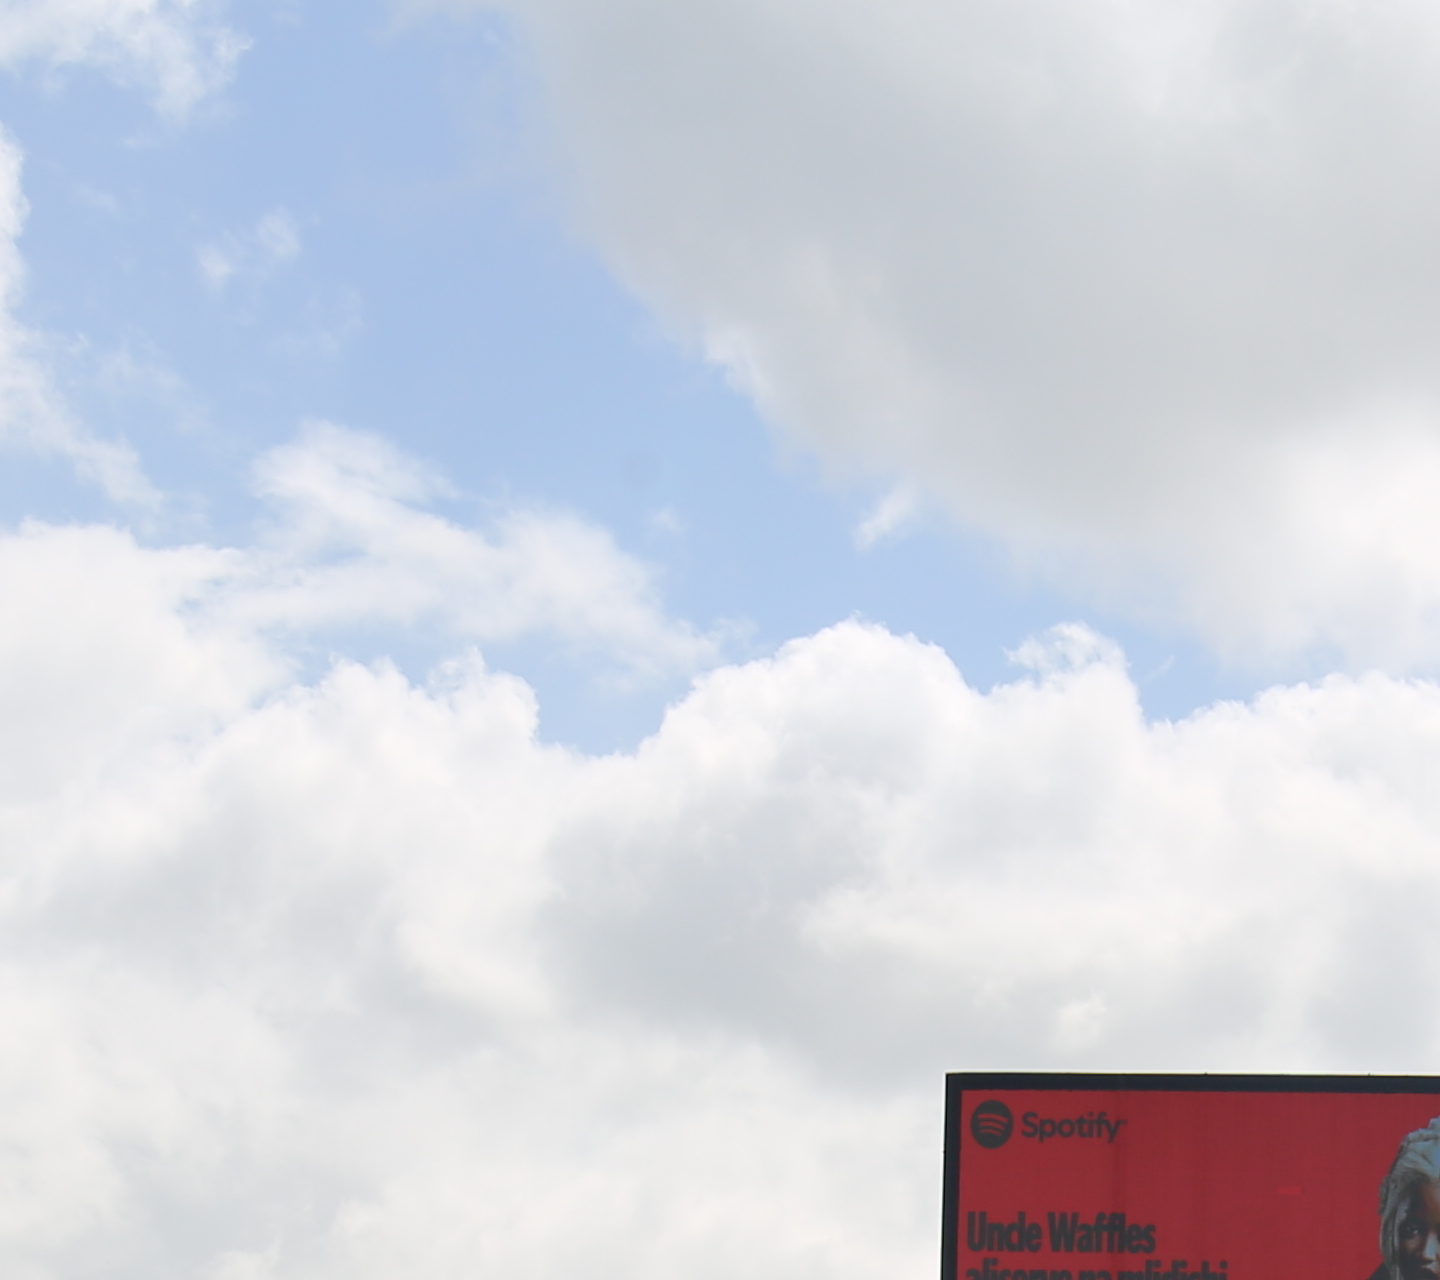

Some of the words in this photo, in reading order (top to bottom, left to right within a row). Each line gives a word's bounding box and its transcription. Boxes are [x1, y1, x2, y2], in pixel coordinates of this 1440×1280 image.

[1021, 1111, 1121, 1144] Spotify
[967, 1211, 1042, 1252] Uncle
[1047, 1211, 1157, 1254] Waffles
